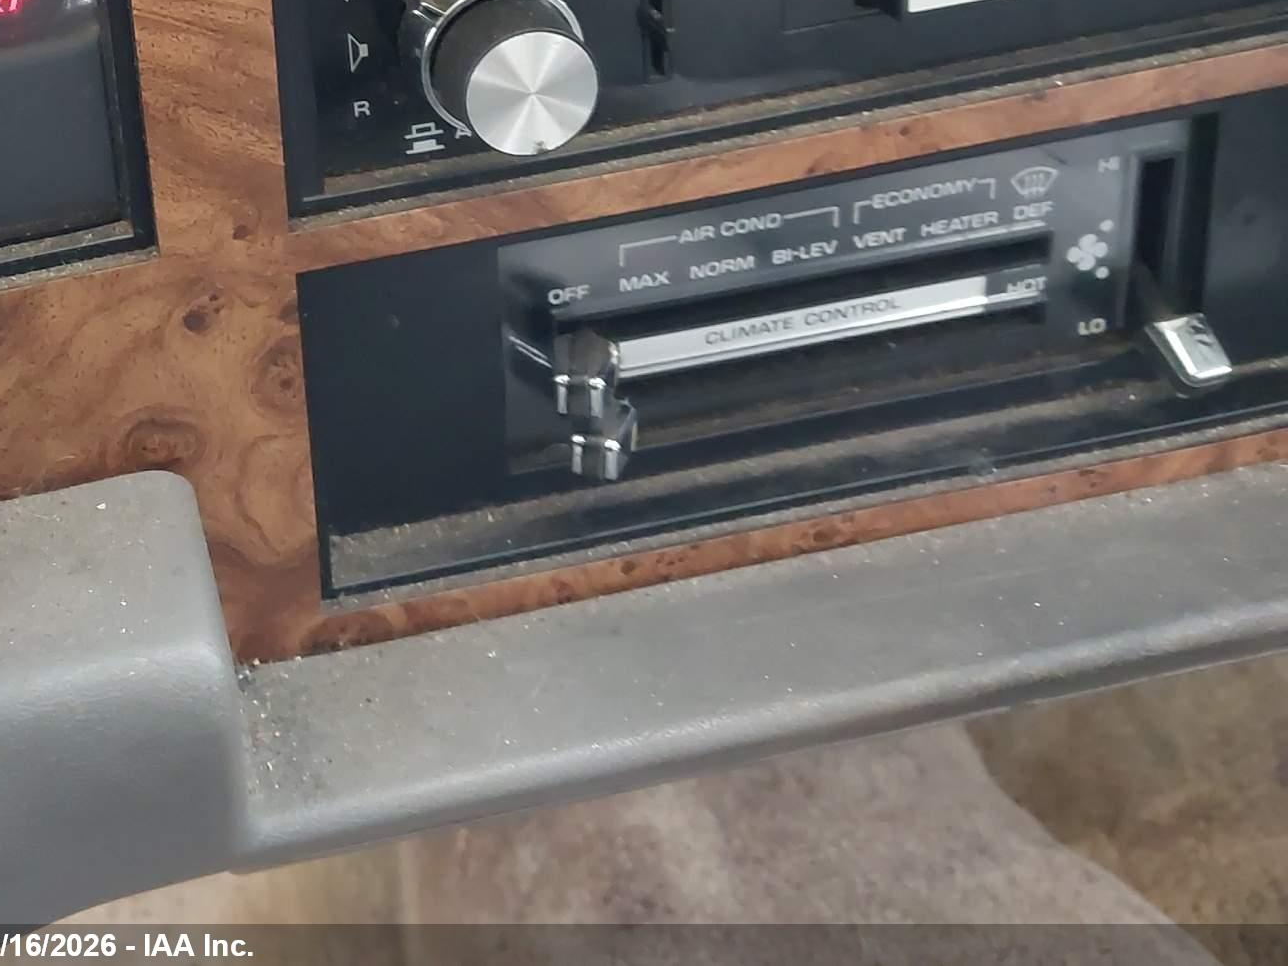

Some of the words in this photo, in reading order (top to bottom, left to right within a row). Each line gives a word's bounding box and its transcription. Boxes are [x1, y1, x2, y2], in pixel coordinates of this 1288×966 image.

[354, 100, 370, 117] R
[873, 180, 976, 210] ECONOMY
[678, 225, 715, 245] AIR
[719, 213, 782, 238] COND
[548, 286, 590, 306] OFF
[618, 270, 670, 292] MAX
[689, 254, 755, 280] NORM
[772, 240, 837, 265] BI-LEV
[854, 227, 906, 249] VENT
[920, 210, 999, 237] HEATER
[1014, 201, 1054, 222] DEF
[1007, 275, 1047, 296] HOT
[705, 315, 794, 345] CLIMATE
[804, 297, 902, 328] CONTROL
[1078, 318, 1105, 336] LO
